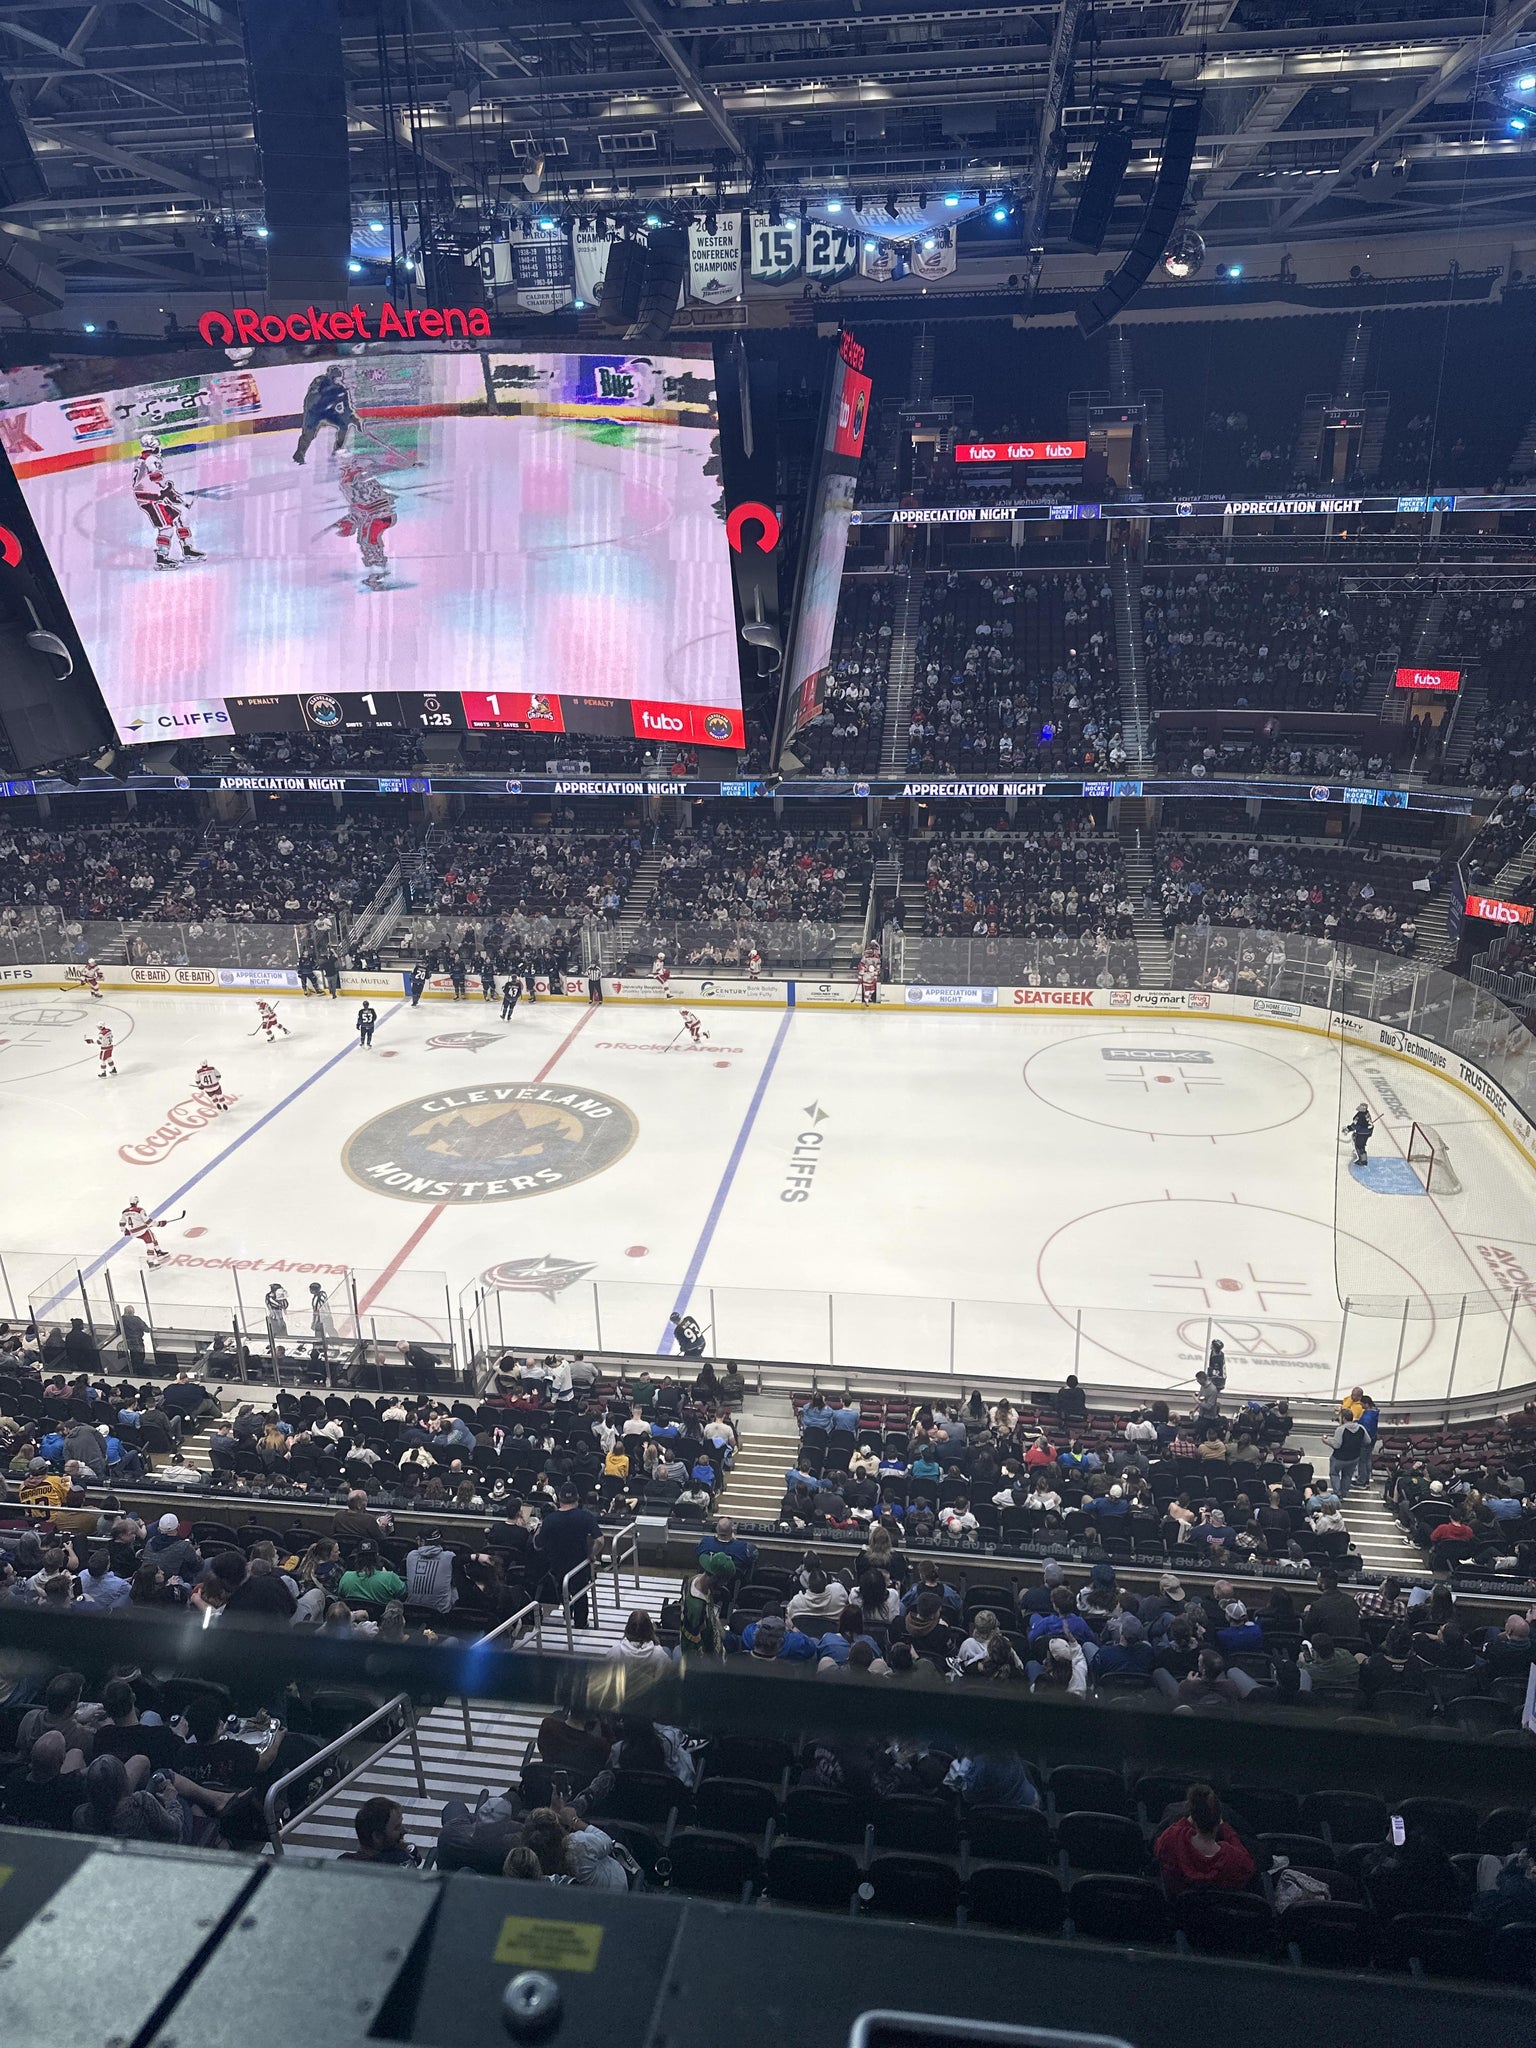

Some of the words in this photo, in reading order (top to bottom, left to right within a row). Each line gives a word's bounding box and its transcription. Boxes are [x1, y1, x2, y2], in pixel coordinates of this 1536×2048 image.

[697, 236, 733, 247] WESTERN
[812, 230, 848, 266] 27
[692, 248, 739, 260] CONFERENCE
[759, 231, 793, 267] 15
[694, 261, 737, 272] CHAMPIONS
[233, 304, 371, 345] Rocket
[379, 302, 491, 338] Arena
[969, 446, 996, 459] fubo
[1007, 446, 1034, 458] fubo
[1045, 445, 1072, 457] fubo
[1224, 502, 1316, 514] APPRECIATION
[1320, 500, 1363, 512] NIGHT
[891, 509, 983, 522] APPRECIATION
[985, 508, 1018, 520] NIGHT
[1414, 673, 1441, 685] fubo
[248, 697, 279, 705] PENALTY
[361, 693, 377, 716] 1
[485, 694, 501, 716] 1
[158, 711, 228, 728] CLIFFS
[419, 713, 452, 726] 1:25
[641, 711, 683, 731] fubo
[219, 776, 307, 790] APPRECIATION
[309, 778, 346, 791] NIGHT
[554, 781, 644, 794] APPRECIATION
[647, 782, 687, 795] NIGHT
[903, 783, 998, 796] APPRECIATION
[1002, 783, 1046, 796] NIGHT
[1346, 792, 1375, 800] HOCKEY
[1478, 901, 1520, 923] fubo
[0, 969, 33, 980] IFFS
[235, 971, 283, 979] APPRECIATION
[415, 969, 426, 980] 20
[508, 986, 519, 998] 43
[925, 989, 977, 997] APPRECIATION
[1013, 989, 1094, 1007] SEATGEEK
[1133, 994, 1158, 1005] drug
[1160, 995, 1186, 1004] mart
[1265, 1003, 1280, 1011] HOME
[362, 1013, 373, 1023] 53
[682, 1043, 744, 1054] Arena
[1380, 1030, 1396, 1046] Blue
[1404, 1038, 1446, 1069] Technologies
[203, 1075, 213, 1085] 41
[1459, 1063, 1508, 1117] TRUSTEDSEC
[421, 1087, 613, 1120] CLEVELAND
[780, 1132, 824, 1203] CLIFFS
[365, 1161, 564, 1197] MONSTERS
[127, 1217, 134, 1228] 4
[169, 1254, 264, 1271] Rocket
[264, 1259, 349, 1276] Arena
[683, 1322, 702, 1343] 93
[1251, 1358, 1331, 1370] WAREHOUSE
